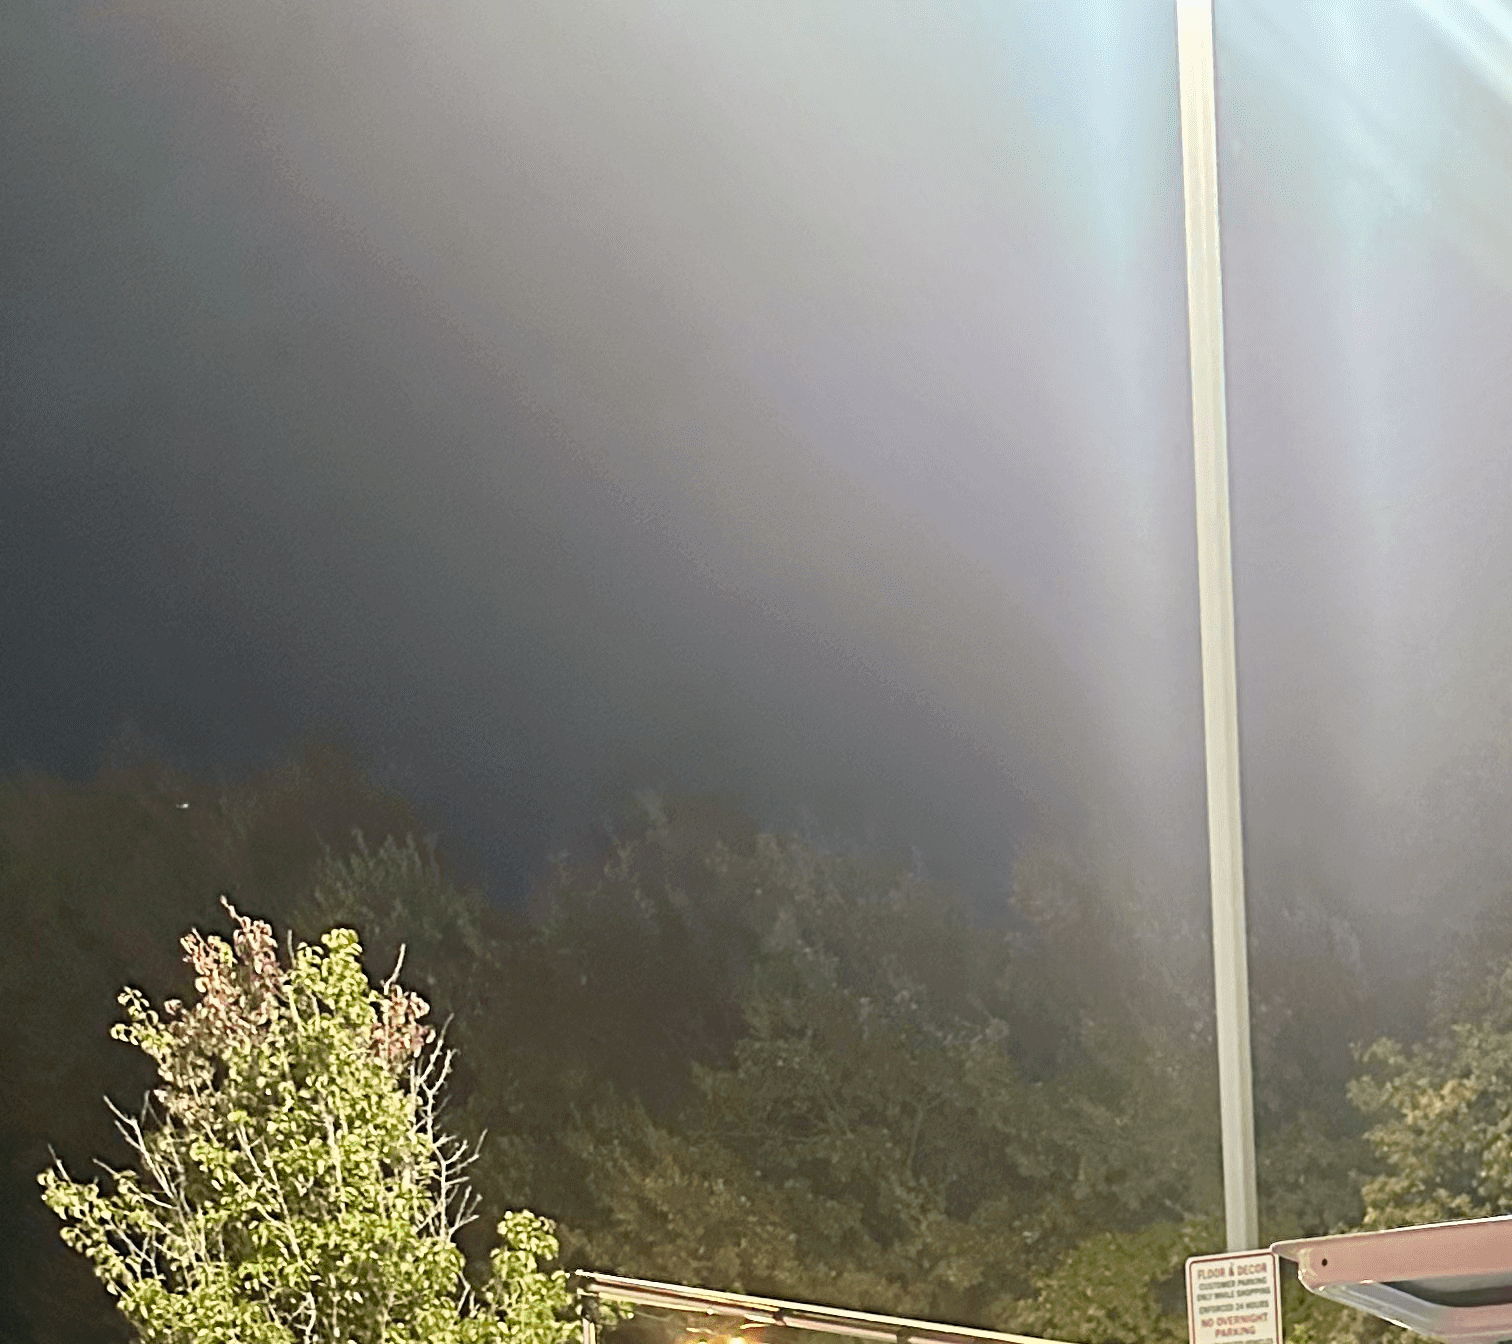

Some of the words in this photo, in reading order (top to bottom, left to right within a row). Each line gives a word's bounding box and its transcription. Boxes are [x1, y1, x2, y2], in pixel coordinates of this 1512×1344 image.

[1198, 1268, 1225, 1279] FLOOR
[1237, 1263, 1267, 1275] DECOR
[1201, 1318, 1214, 1328] NO
[1216, 1312, 1267, 1326] OVERNIGHT
[1215, 1325, 1256, 1339] PARKING
